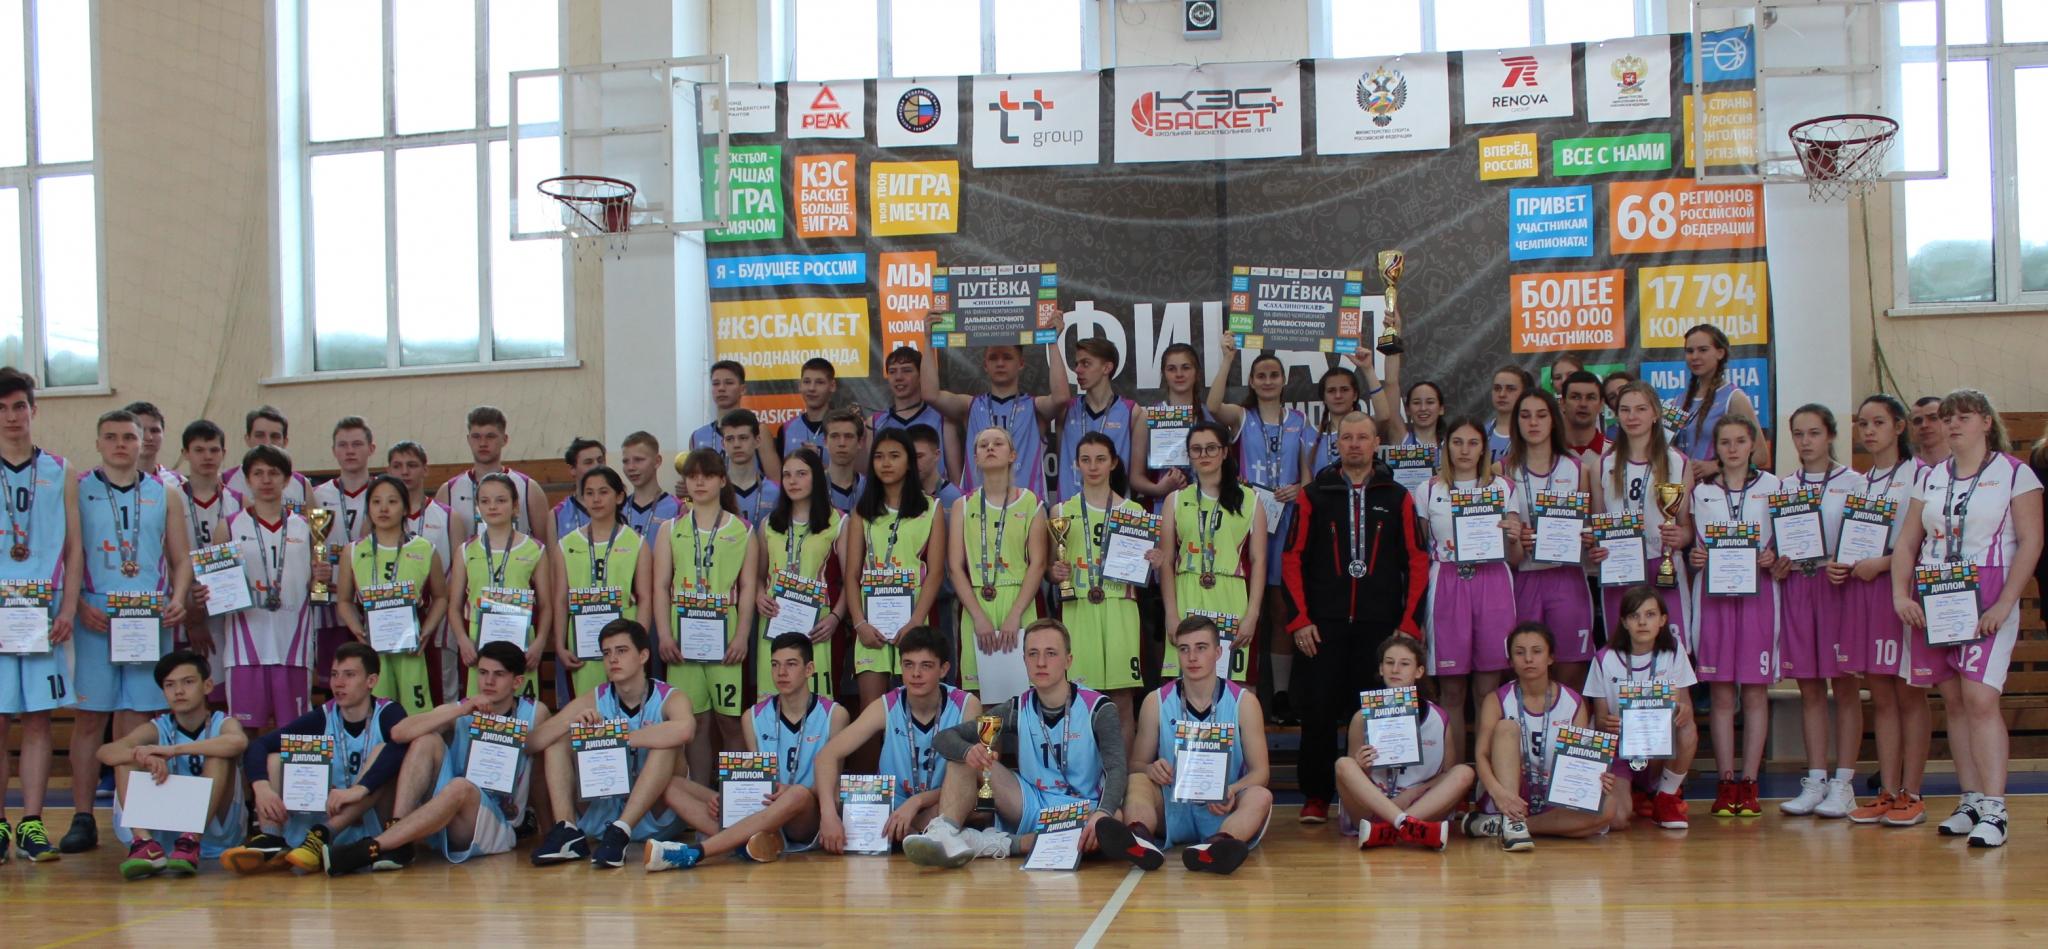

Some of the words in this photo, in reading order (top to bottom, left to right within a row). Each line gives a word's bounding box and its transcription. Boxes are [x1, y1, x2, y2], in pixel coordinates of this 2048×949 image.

[1492, 94, 1548, 108] RENOVA
[802, 112, 850, 129] PEAK
[1155, 109, 1271, 130] БАСКЕТ
[1033, 128, 1083, 147] group
[1484, 140, 1532, 156] ВПЕРЁД,
[1562, 147, 1594, 166] ВСЕ
[1597, 146, 1609, 162] С
[1613, 143, 1665, 162] НАМИ
[802, 160, 848, 188] КЭС
[1484, 160, 1533, 172] РОССИЯ!
[878, 172, 888, 199] ТВОЯ
[889, 173, 951, 196] ИГРА
[802, 188, 848, 202] БАСКЕТ
[1680, 188, 1754, 206] РЕГИОНОВ
[802, 202, 853, 215] БОЛЬШЕ,
[880, 202, 888, 224] ТВОЯ
[890, 202, 950, 222] МЕЧТА
[1516, 194, 1586, 216] ПРИВЕТ
[1680, 204, 1754, 221] РОССИЙСКОЙ
[808, 215, 848, 231] ИГРА
[1617, 192, 1677, 240] 68
[1516, 218, 1588, 234] УЧАСТНИКАМ
[1680, 222, 1754, 238] ФЕДЕРАЦИИ
[1516, 236, 1588, 251] ЧЕМПИОНАТА!
[716, 265, 726, 279] Я
[738, 261, 800, 280] БУДУЩЕЕ
[804, 260, 857, 276] РОССИИ
[886, 263, 931, 288] МЫ
[958, 277, 1030, 297] ПУТЁВКА
[1258, 280, 1333, 301] ПУТЁВКА
[1521, 277, 1614, 308] БОЛЕЕ
[1648, 275, 1684, 309] 17
[1692, 274, 1756, 308] 794
[886, 294, 930, 312] ОДНА
[934, 295, 946, 305] 68
[1234, 294, 1246, 304] 68
[964, 316, 1024, 324] ДАЛЬНЕВОСТОЧНОГО
[1262, 320, 1326, 328] ДАЛЬНЕВОСТОЧНОГО
[1521, 312, 1530, 328] 1
[1535, 309, 1571, 328] 500
[1576, 307, 1612, 326] 000
[718, 312, 861, 340] #КЭСБАСКЕТ
[1521, 330, 1614, 347] УЧАСТНИКОВ
[1651, 370, 1686, 389] МЫ
[1157, 419, 1184, 428] ДИПЛОМ
[1629, 478, 1641, 500] 8
[120, 506, 128, 530] 1
[1463, 505, 1494, 516] ДИПЛОМ
[1546, 508, 1576, 517] ДИПЛОМ
[1780, 504, 1810, 516] ДИПЛОМ
[1852, 510, 1883, 522] ДИПЛОМ
[1094, 522, 1106, 547] 9
[1119, 526, 1148, 538] ДИПЛОМ
[1605, 528, 1634, 538] ДИПЛОМ
[1716, 538, 1748, 548] ДИПЛОМ
[271, 545, 278, 568] 1
[204, 558, 234, 572] ДИПЛОМ
[384, 562, 395, 580] 5
[874, 586, 903, 596] ДИПЛОМ
[1931, 580, 1966, 594] ДИПЛОМ
[374, 598, 404, 610] ДИПЛОМ
[784, 589, 812, 604] ДИПЛОМ
[119, 608, 152, 617] ДИПЛОМ
[582, 604, 612, 614] ДИПЛОМ
[688, 608, 716, 618] ДИПЛОМ
[1578, 629, 1588, 654] 7
[1875, 639, 1898, 666] 10
[1130, 656, 1141, 681] 9
[1760, 650, 1770, 676] 9
[414, 684, 426, 708] 5
[524, 679, 536, 700] 4
[714, 684, 736, 708] 12
[1631, 698, 1664, 707] ДИПЛОМ
[1374, 706, 1406, 717] ДИПЛОМ
[480, 732, 514, 744] ДИПЛОМ
[585, 738, 617, 750] ДИПЛОМ
[1532, 731, 1543, 756] 5
[1566, 746, 1601, 760] ДИПЛОМ
[349, 750, 361, 774] 9
[731, 771, 764, 780] ДИПЛОМ
[852, 793, 882, 802] ДИПЛОМ
[1047, 820, 1077, 832] ДИПЛОМ
